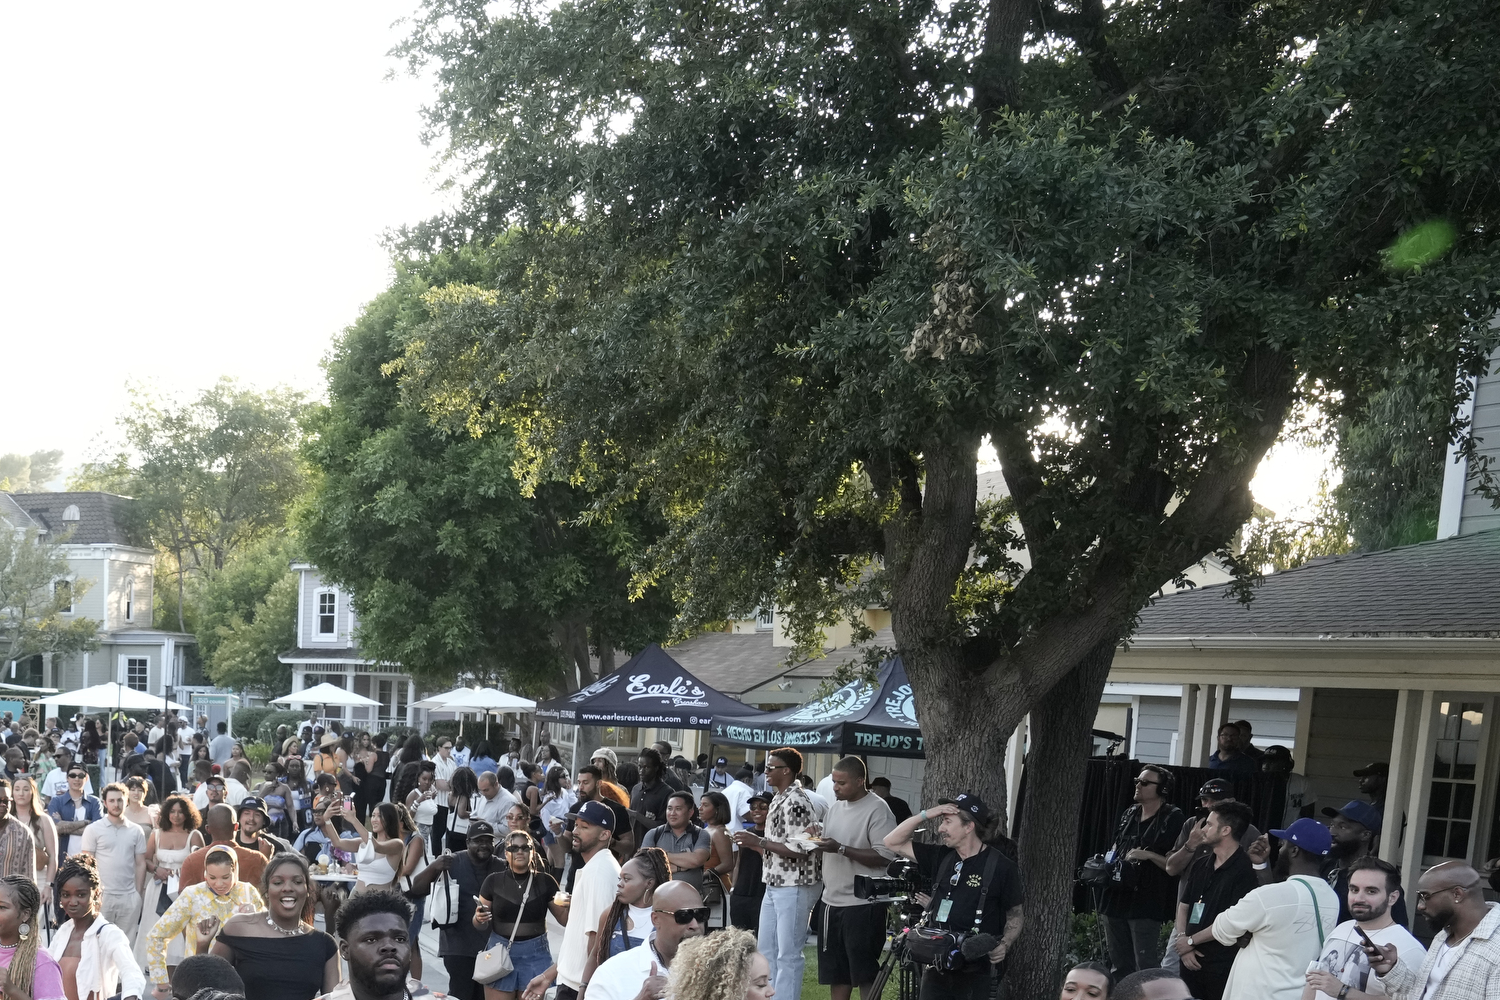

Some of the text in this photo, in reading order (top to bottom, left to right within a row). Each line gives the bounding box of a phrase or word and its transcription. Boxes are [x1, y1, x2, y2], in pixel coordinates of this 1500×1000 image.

[626, 674, 705, 698] Earle's
[885, 683, 913, 719] TREJO
[582, 713, 681, 723] www.earlesrestaurant.com
[727, 725, 822, 745] HECHO EN LOS ANGELES
[855, 732, 912, 749] TREJO'S
